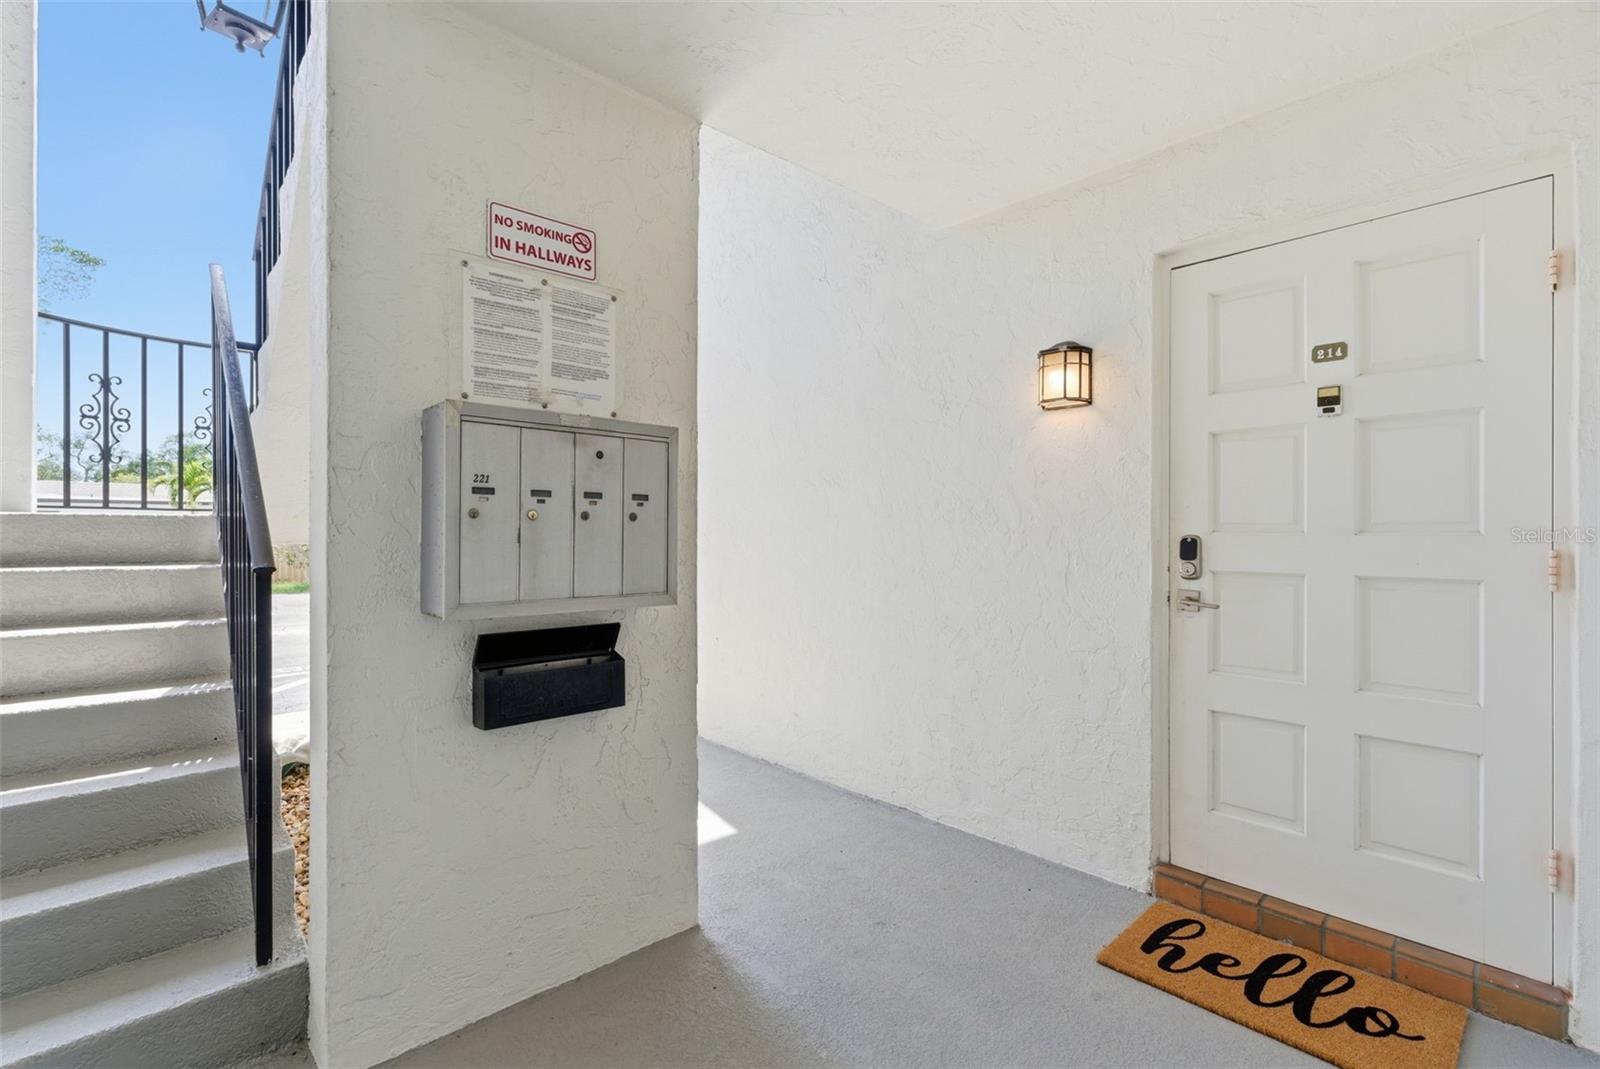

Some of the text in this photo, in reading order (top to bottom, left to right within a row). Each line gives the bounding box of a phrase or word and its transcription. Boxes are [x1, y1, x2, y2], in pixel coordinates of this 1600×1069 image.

[494, 214, 573, 244] NO SMOKING
[494, 235, 592, 272] IN HALLWAYS
[1316, 346, 1343, 360] 214
[473, 473, 490, 483] 221
[1140, 918, 1425, 1041] hello
